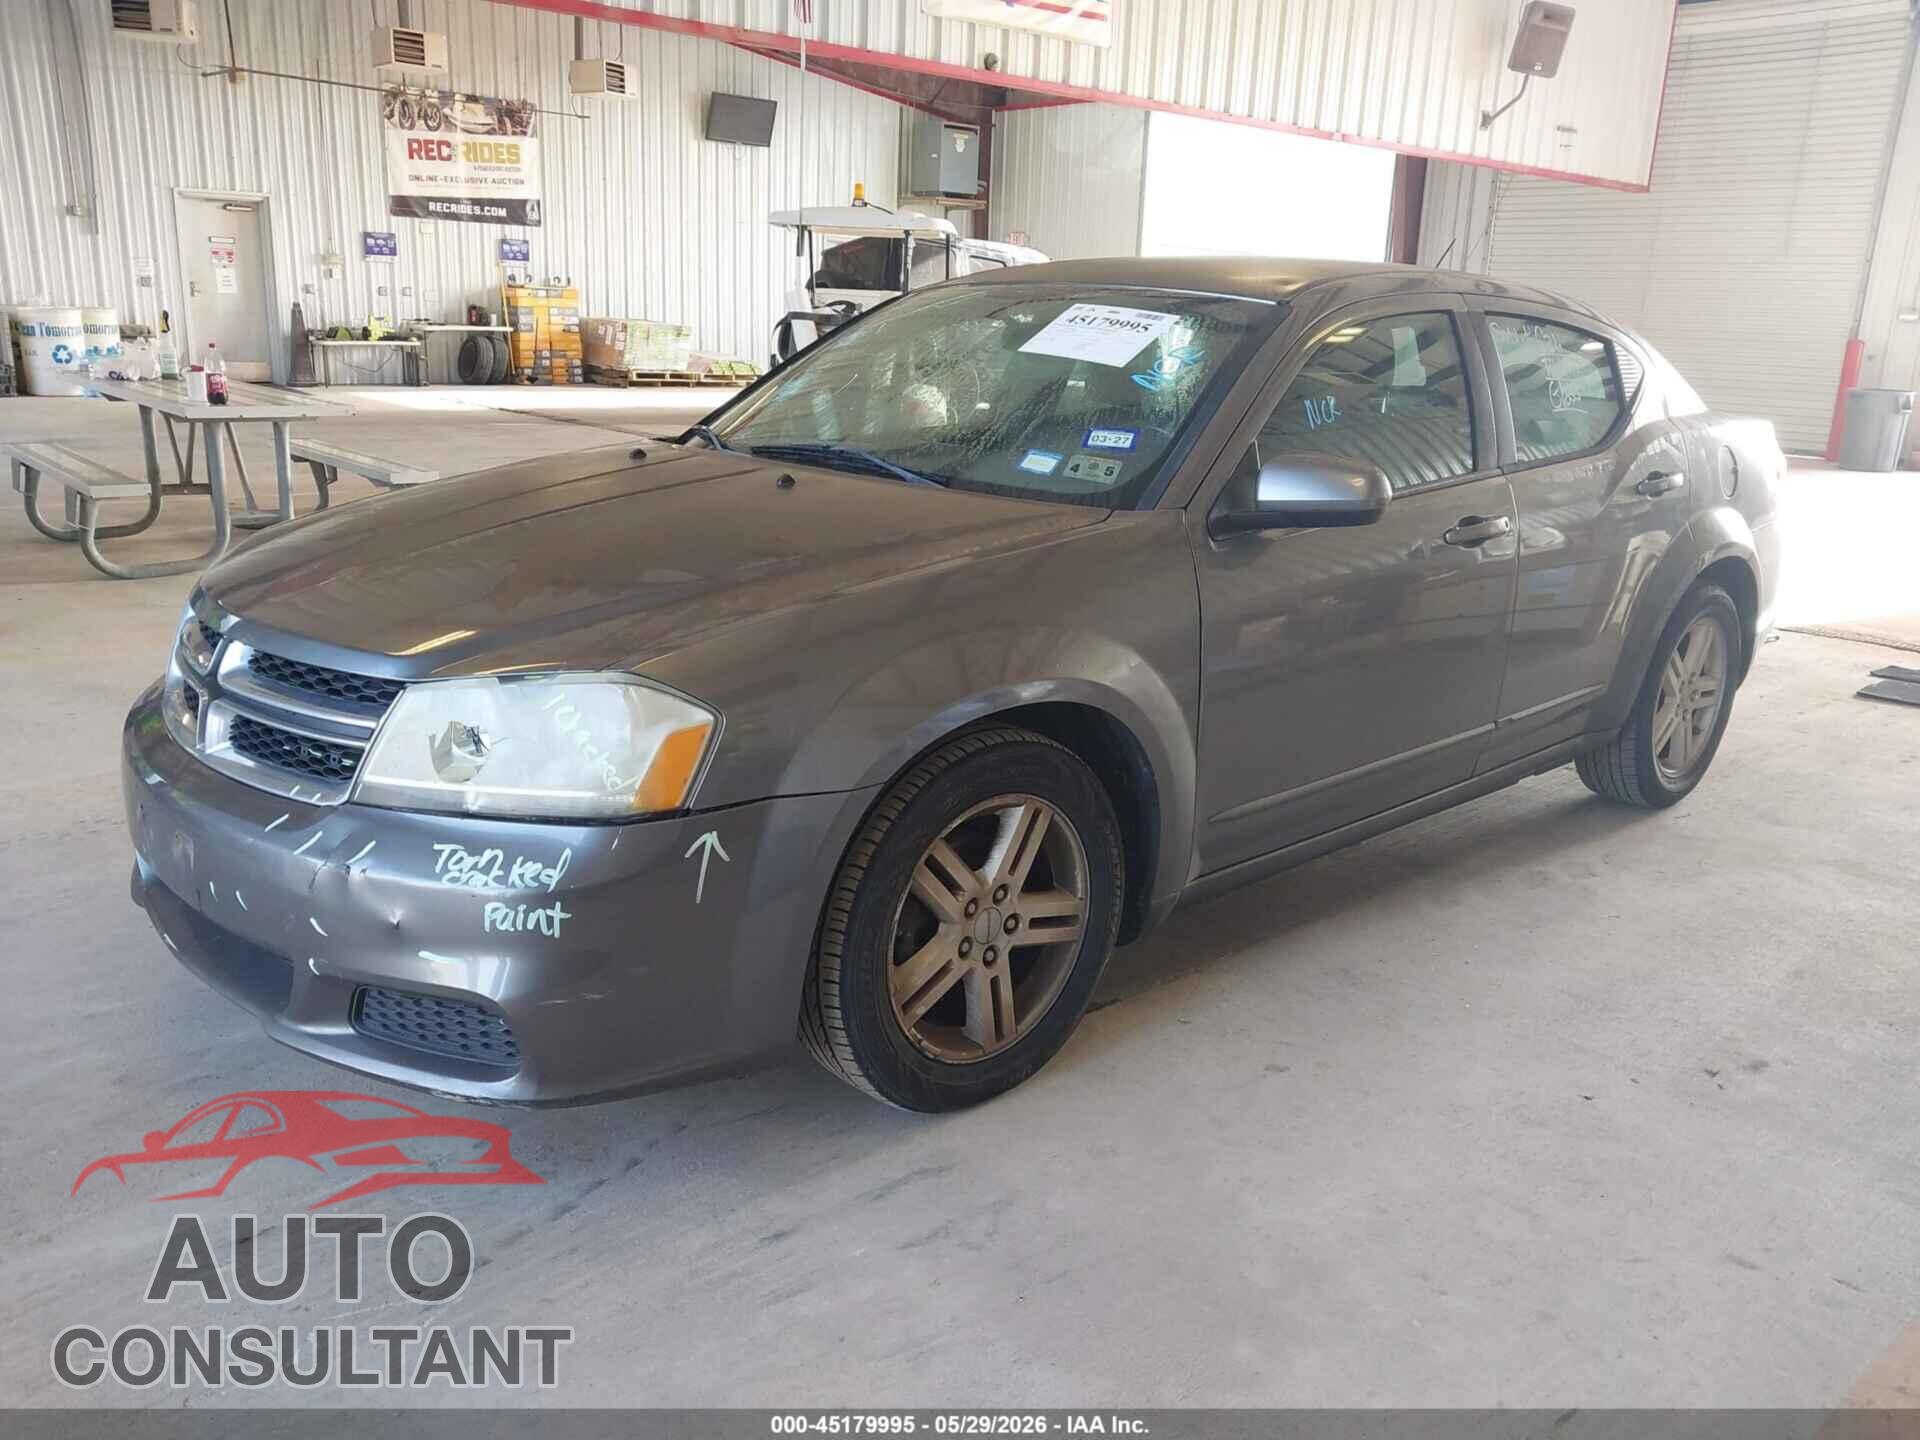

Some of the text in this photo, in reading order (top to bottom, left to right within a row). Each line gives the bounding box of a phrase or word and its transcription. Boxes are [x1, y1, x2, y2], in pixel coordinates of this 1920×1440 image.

[407, 138, 452, 162] REC
[491, 176, 525, 185] AUCTION
[428, 201, 507, 217] RECRIDES.COM
[1066, 311, 1153, 333] 45179995
[1070, 463, 1116, 477] 4 5
[483, 901, 573, 938] Paint
